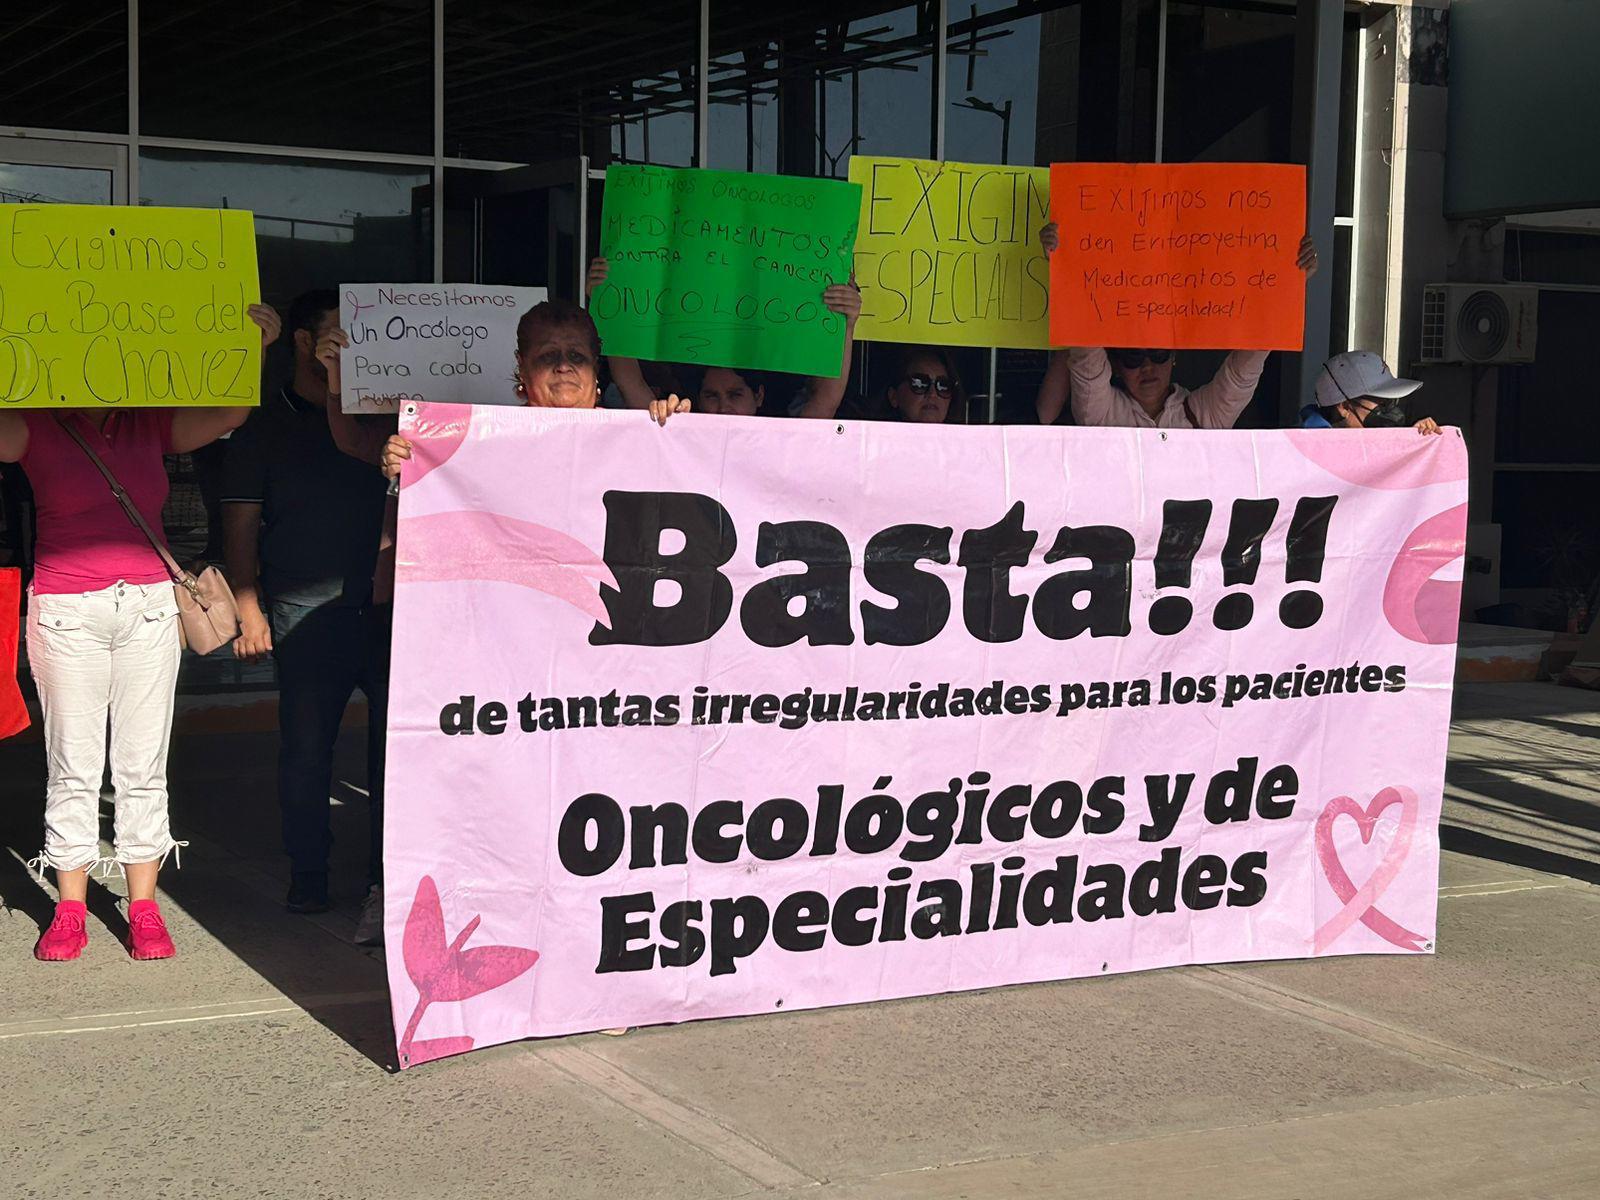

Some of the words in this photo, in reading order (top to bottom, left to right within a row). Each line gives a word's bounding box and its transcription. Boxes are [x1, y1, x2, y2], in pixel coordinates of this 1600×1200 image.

[1229, 189, 1271, 209] nos
[12, 208, 226, 271] Exigimos!
[608, 206, 830, 259] MEDICAMENTOS
[706, 252, 729, 265] EL
[1080, 233, 1113, 253] den
[1133, 228, 1278, 255] Eritopoyetina
[378, 288, 516, 308] Necesitamos
[1083, 268, 1235, 288] Medicamentos
[1248, 269, 1277, 288] de
[0, 284, 58, 334] La
[66, 280, 177, 334] Base
[196, 282, 245, 333] del
[350, 322, 377, 344] Un
[386, 316, 489, 349] Oncólogo
[0, 335, 66, 402] Dr.
[83, 335, 253, 403] Chavez
[355, 355, 411, 378] Para
[429, 351, 482, 377] cada
[588, 490, 1338, 647] Basta!!!
[440, 696, 507, 735] de
[518, 689, 679, 732] tantas
[692, 680, 1051, 729] irregularidades
[1056, 680, 1150, 716] para
[1159, 672, 1216, 704] los
[1222, 661, 1405, 707] pacientes
[558, 772, 1125, 876] Oncológicos
[1139, 773, 1195, 842] y
[1204, 757, 1298, 824] de
[596, 847, 1268, 976] Especialidades
